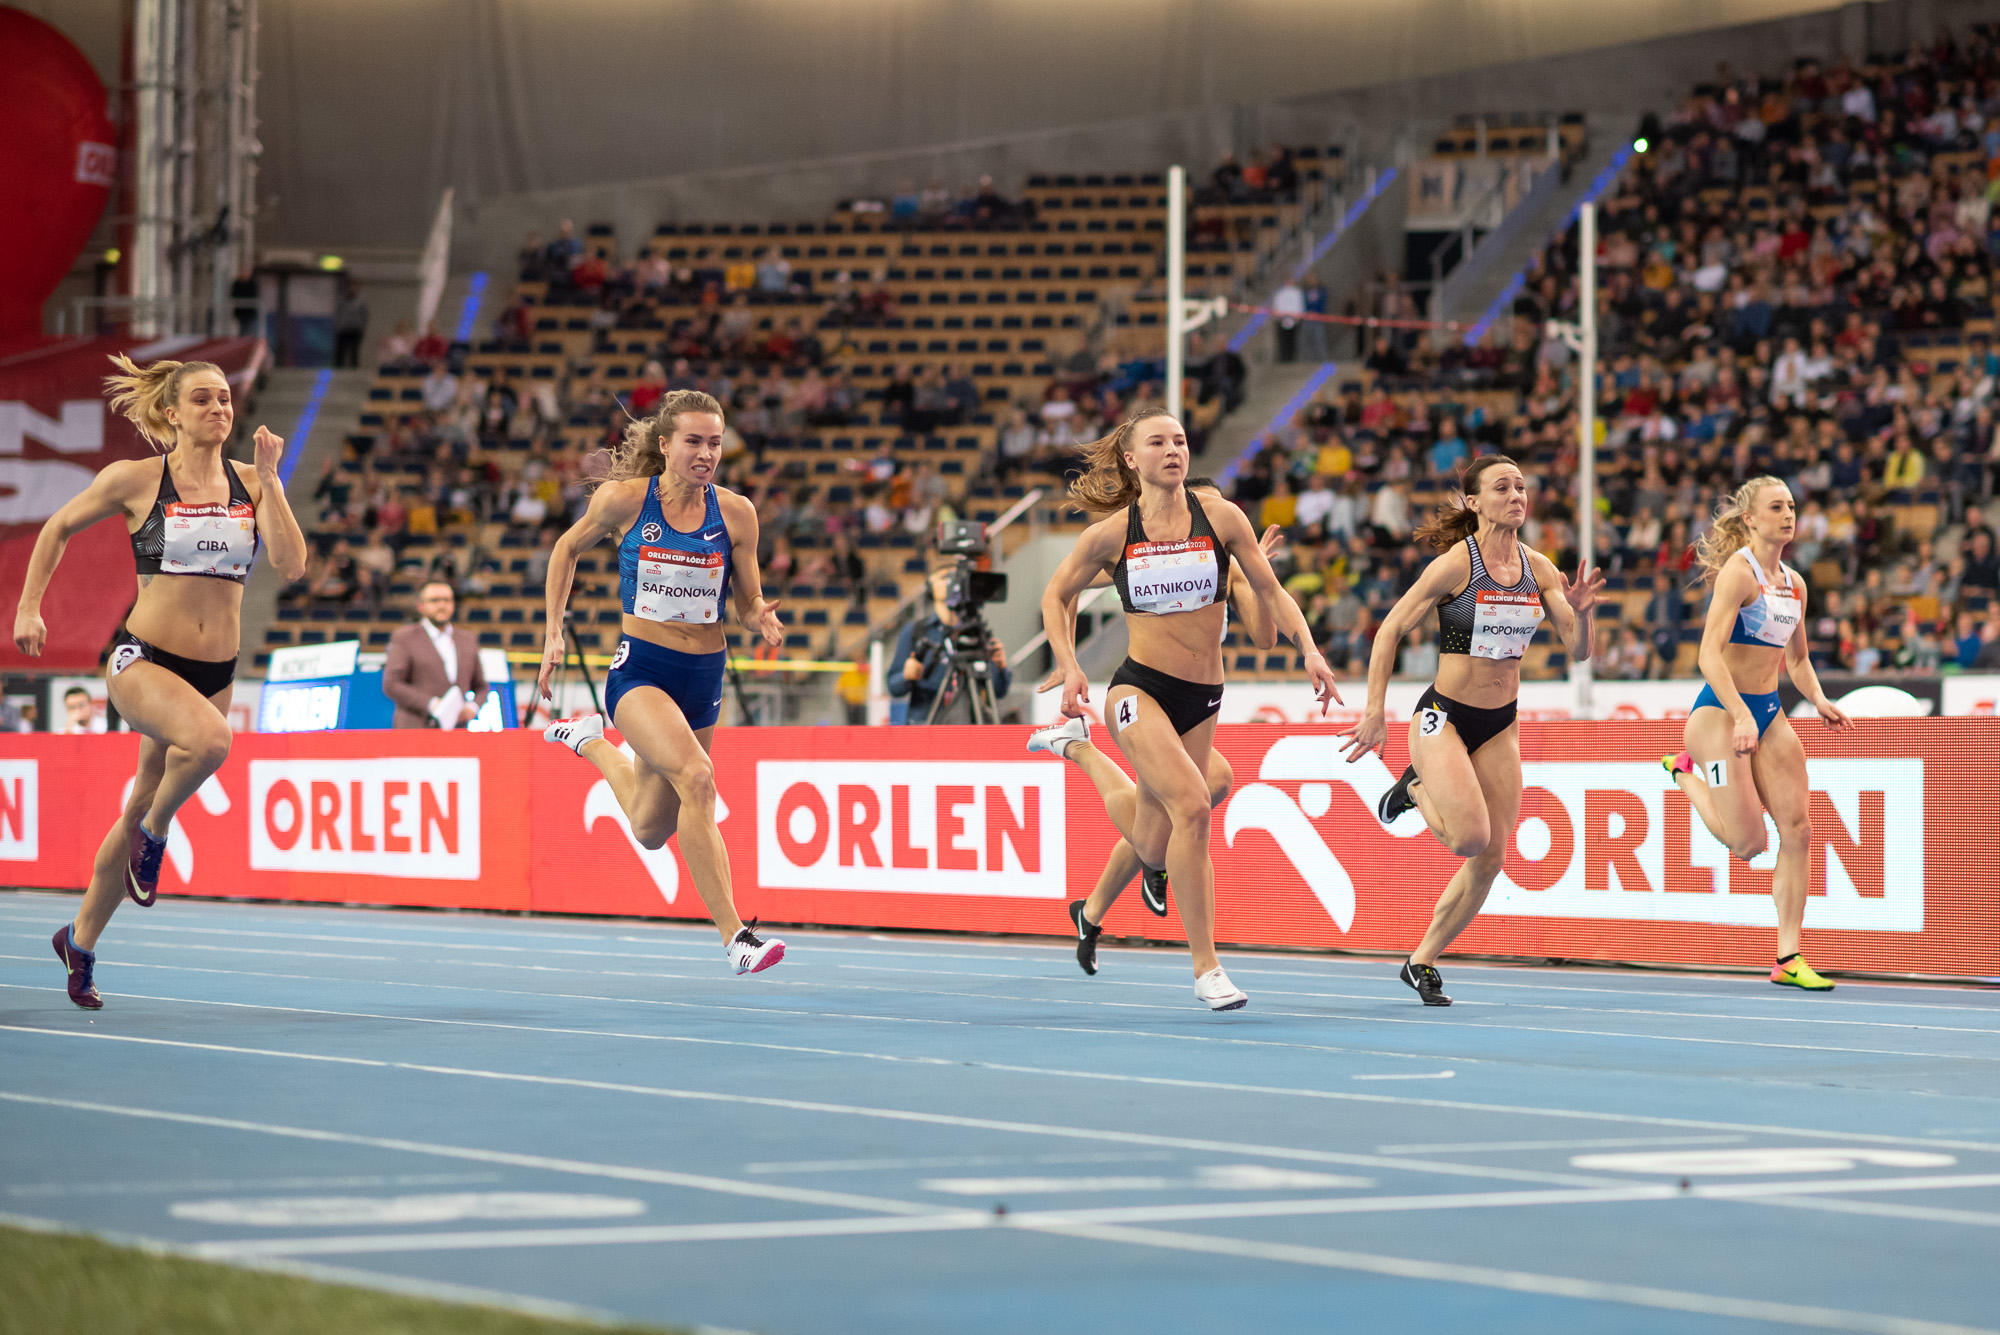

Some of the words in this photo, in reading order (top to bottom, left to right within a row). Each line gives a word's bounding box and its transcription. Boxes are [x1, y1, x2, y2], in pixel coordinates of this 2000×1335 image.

[173, 506, 197, 515] ORLEN
[197, 540, 229, 552] CIBA
[1133, 545, 1156, 555] ORLEN
[1156, 544, 1170, 552] CUP
[1170, 541, 1190, 551] ŁÓDŹ
[647, 551, 671, 560] ORLEN
[686, 556, 706, 565] ŁÓDŹ
[642, 582, 717, 598] SAFRONOVA
[1134, 578, 1212, 597] RATNIKOVA
[1483, 594, 1503, 602] ORLEN
[1482, 625, 1535, 635] POPOWICZ
[1120, 699, 1132, 724] 4
[1423, 711, 1439, 734] 3
[1711, 763, 1720, 785] 1
[265, 778, 459, 855] ORLEN
[776, 781, 1041, 873] ORLEN
